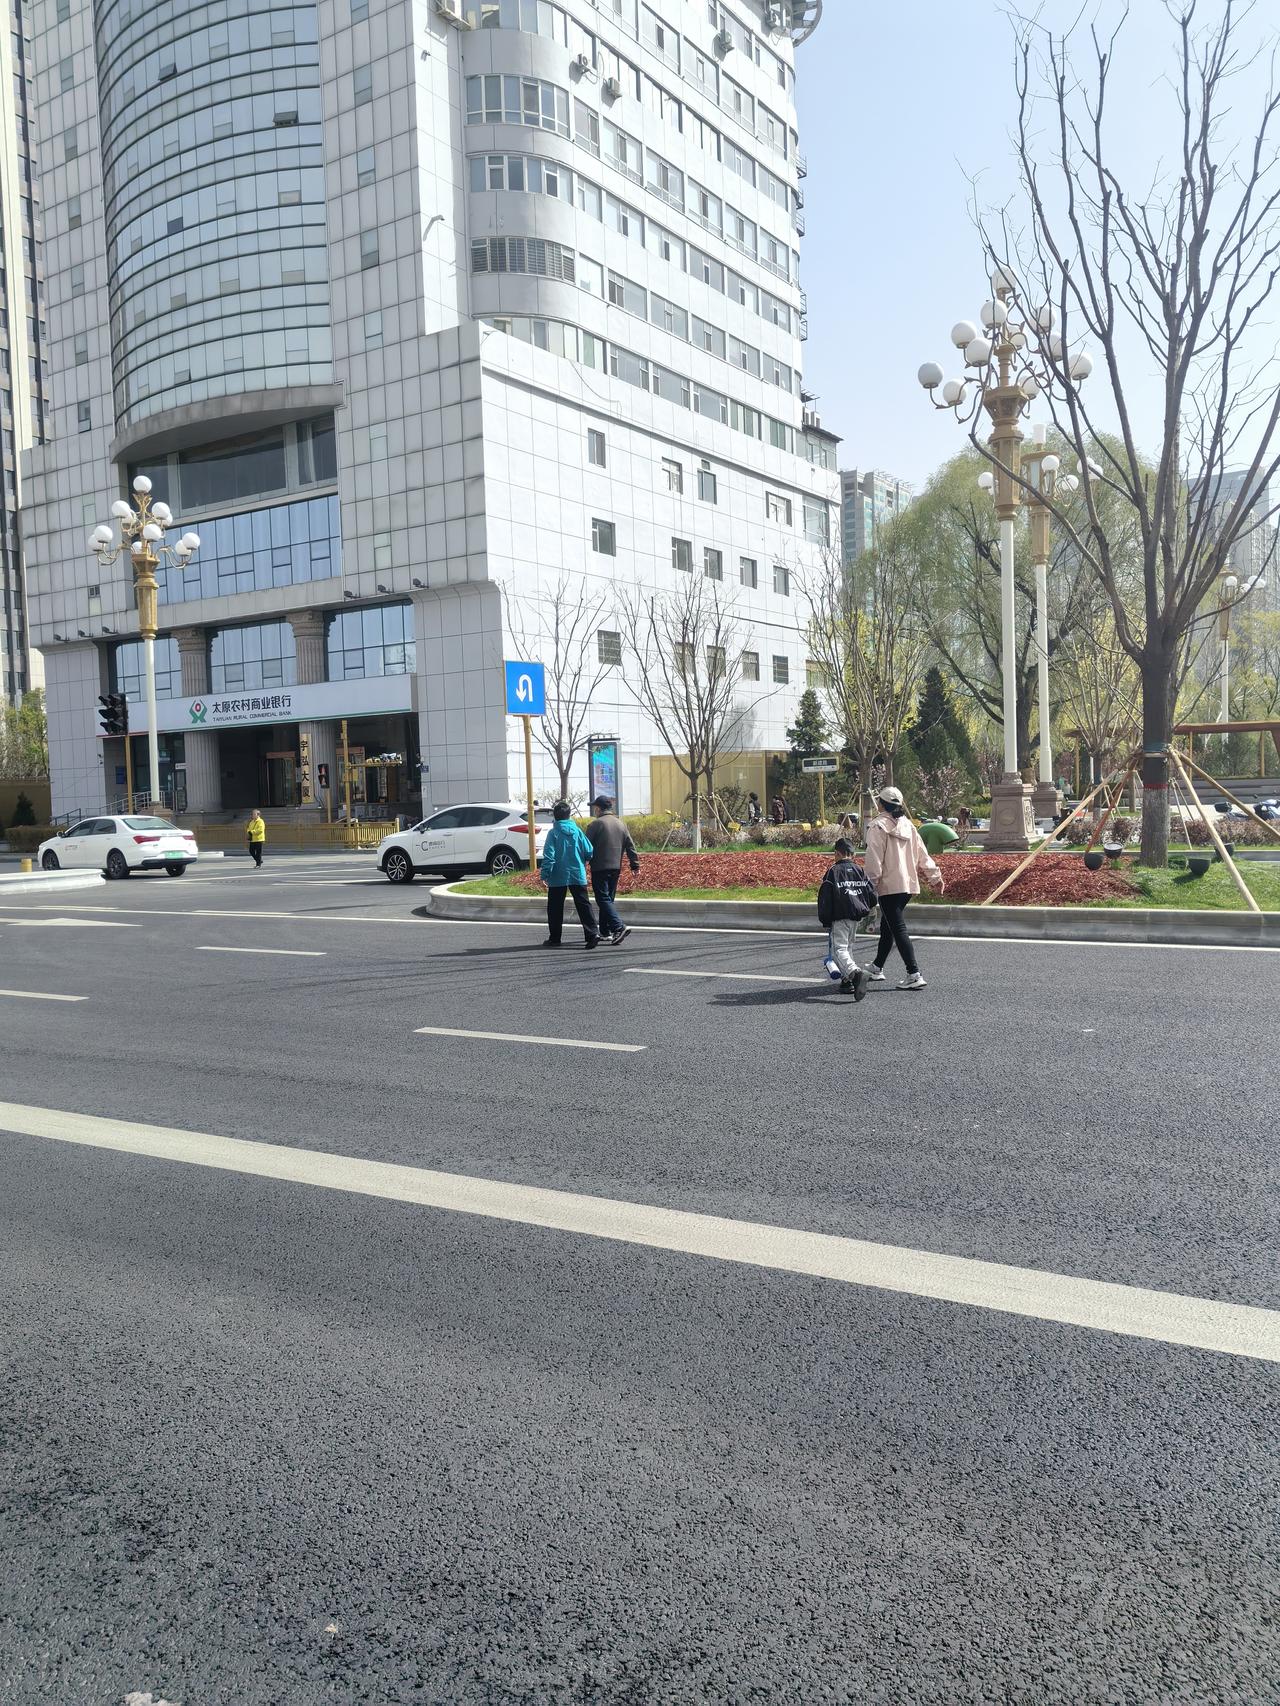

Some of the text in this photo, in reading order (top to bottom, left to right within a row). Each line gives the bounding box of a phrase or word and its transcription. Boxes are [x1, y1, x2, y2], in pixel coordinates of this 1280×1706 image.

[212, 695, 291, 714] 太原农村商业银行
